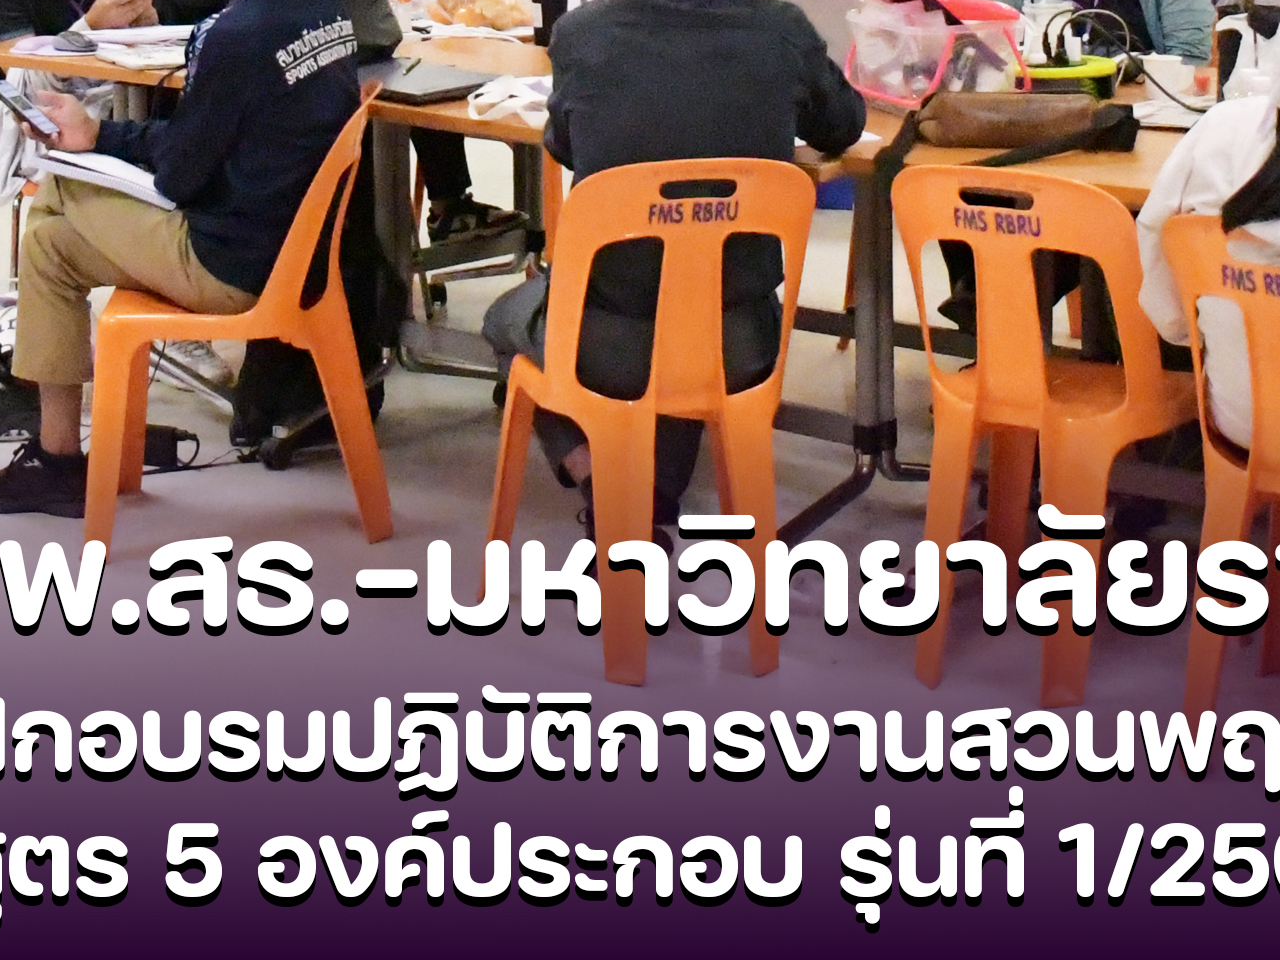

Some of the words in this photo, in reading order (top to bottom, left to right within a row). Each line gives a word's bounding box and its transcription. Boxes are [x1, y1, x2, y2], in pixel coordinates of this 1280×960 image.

[285, 57, 318, 85] SPORTS
[648, 203, 684, 225] FMS
[692, 200, 739, 222] RBRU
[954, 207, 988, 232] FMS
[995, 212, 1041, 237] RBRU
[1222, 264, 1257, 293] FMS
